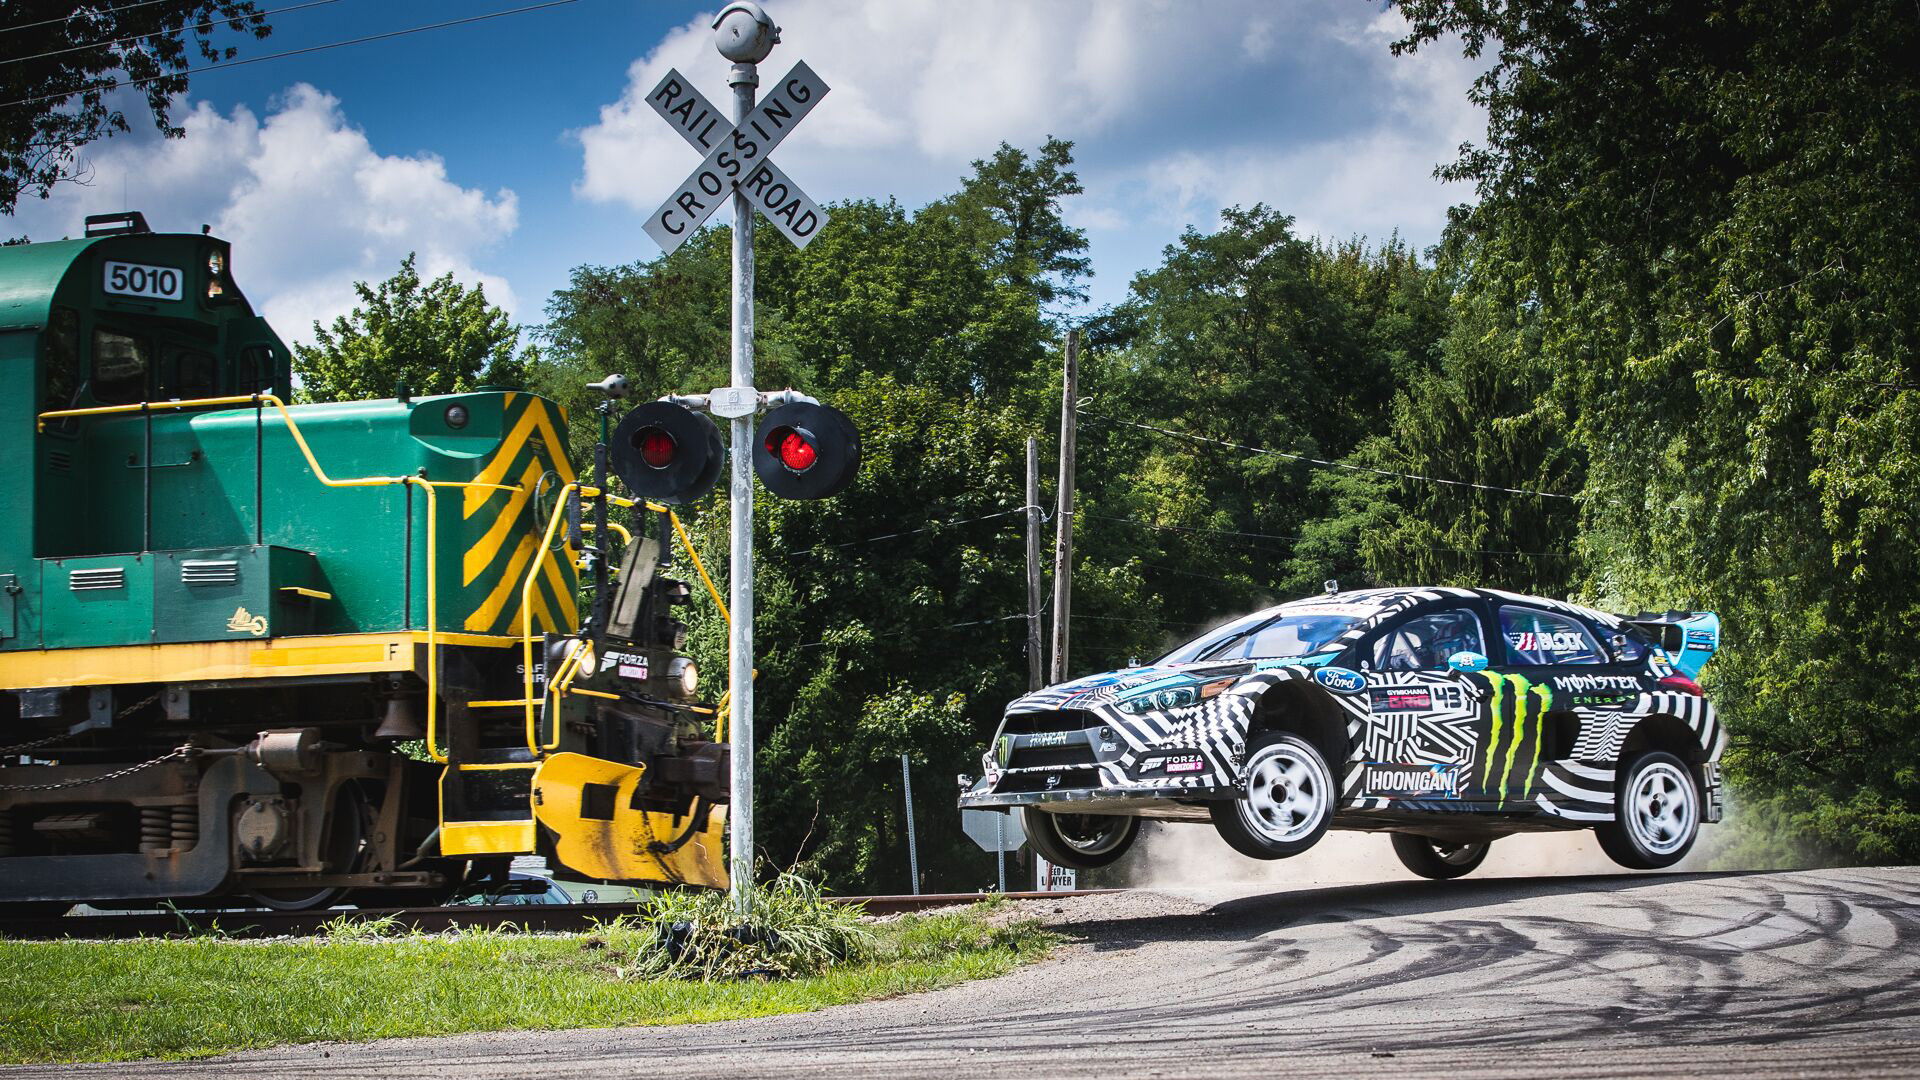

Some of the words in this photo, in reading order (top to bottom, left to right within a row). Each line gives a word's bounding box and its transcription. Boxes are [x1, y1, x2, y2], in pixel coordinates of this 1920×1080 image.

[655, 78, 718, 149] RAIL
[746, 166, 818, 238] ROAD
[661, 79, 811, 235] CROSSING
[111, 265, 177, 296] 5010
[1536, 632, 1588, 651] BLOCK
[389, 643, 399, 661] F
[619, 653, 649, 667] FORZA
[1325, 670, 1357, 690] Ford
[1386, 688, 1429, 696] GYMKHANA
[1434, 687, 1462, 709] 43
[1166, 755, 1203, 764] FORZA
[1196, 761, 1203, 770] 3
